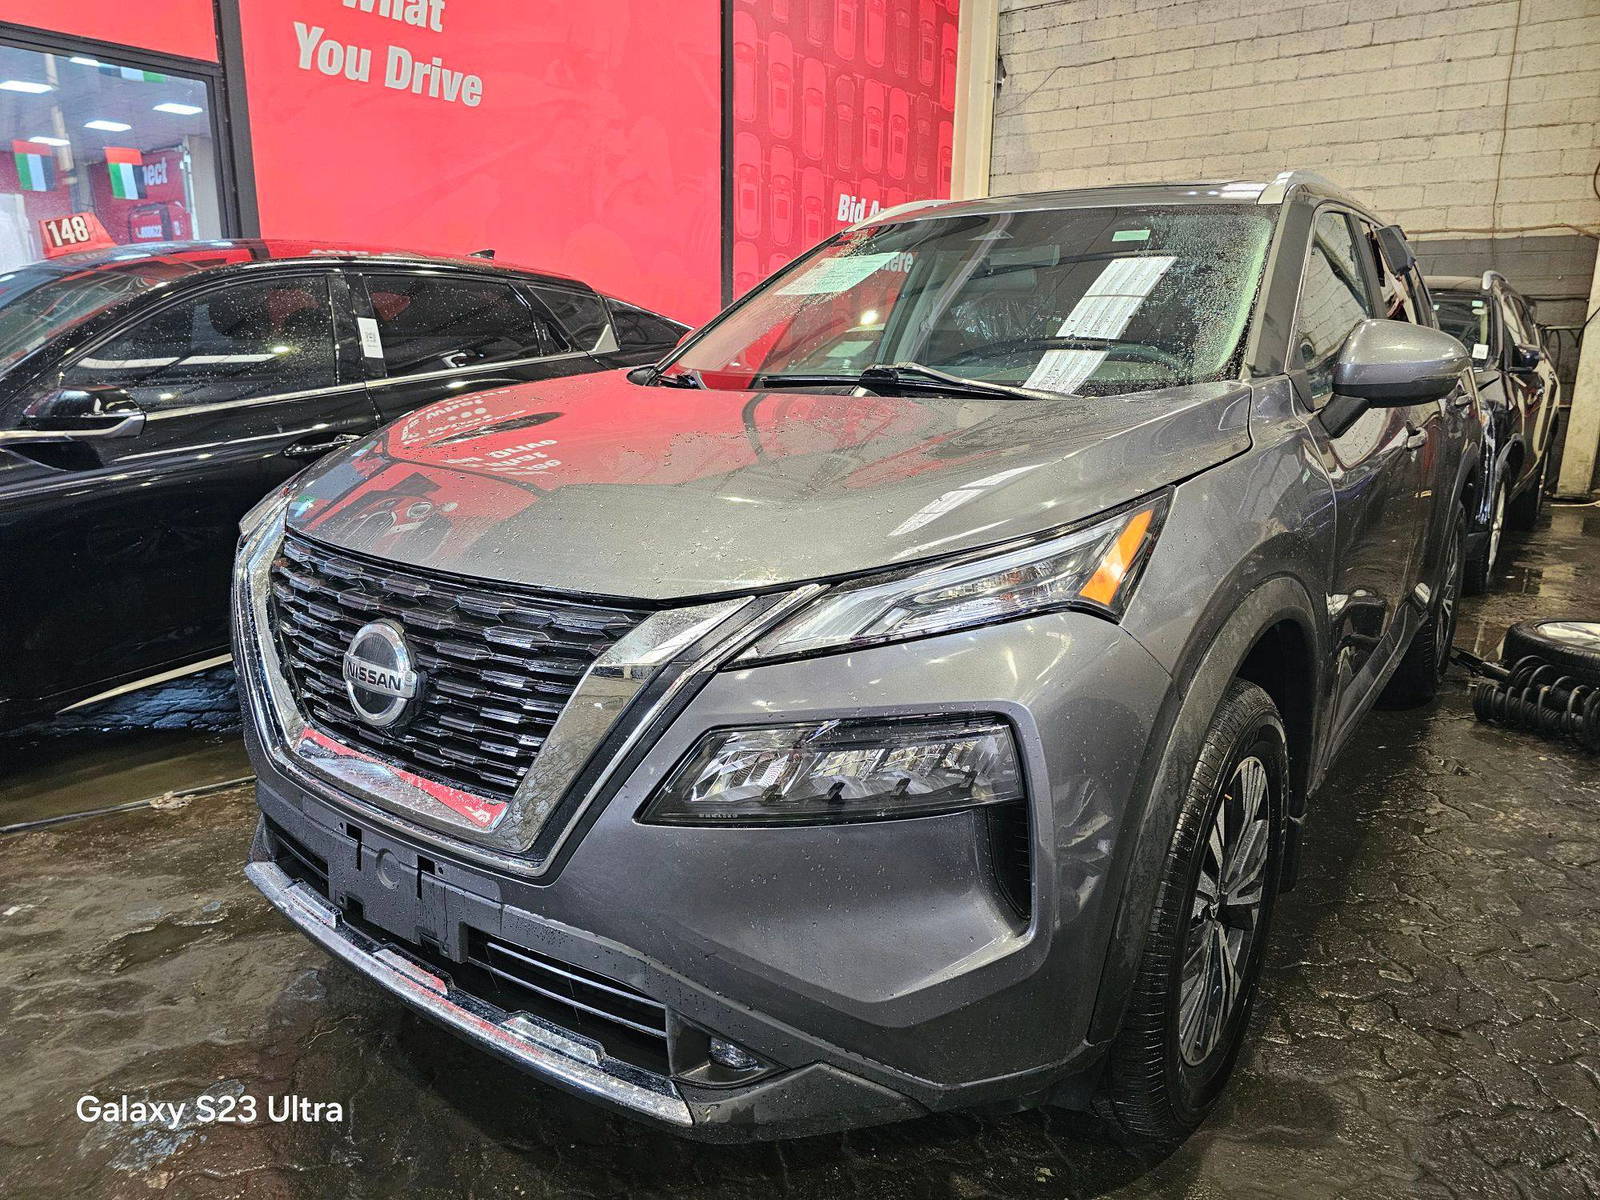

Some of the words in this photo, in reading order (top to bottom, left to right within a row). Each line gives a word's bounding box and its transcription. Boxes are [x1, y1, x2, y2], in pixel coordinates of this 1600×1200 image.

[342, 0, 446, 33] at
[293, 21, 372, 83] You
[384, 45, 483, 107] Drive
[837, 194, 866, 223] Bid
[48, 216, 90, 247] 148
[346, 661, 402, 691] NISSAN
